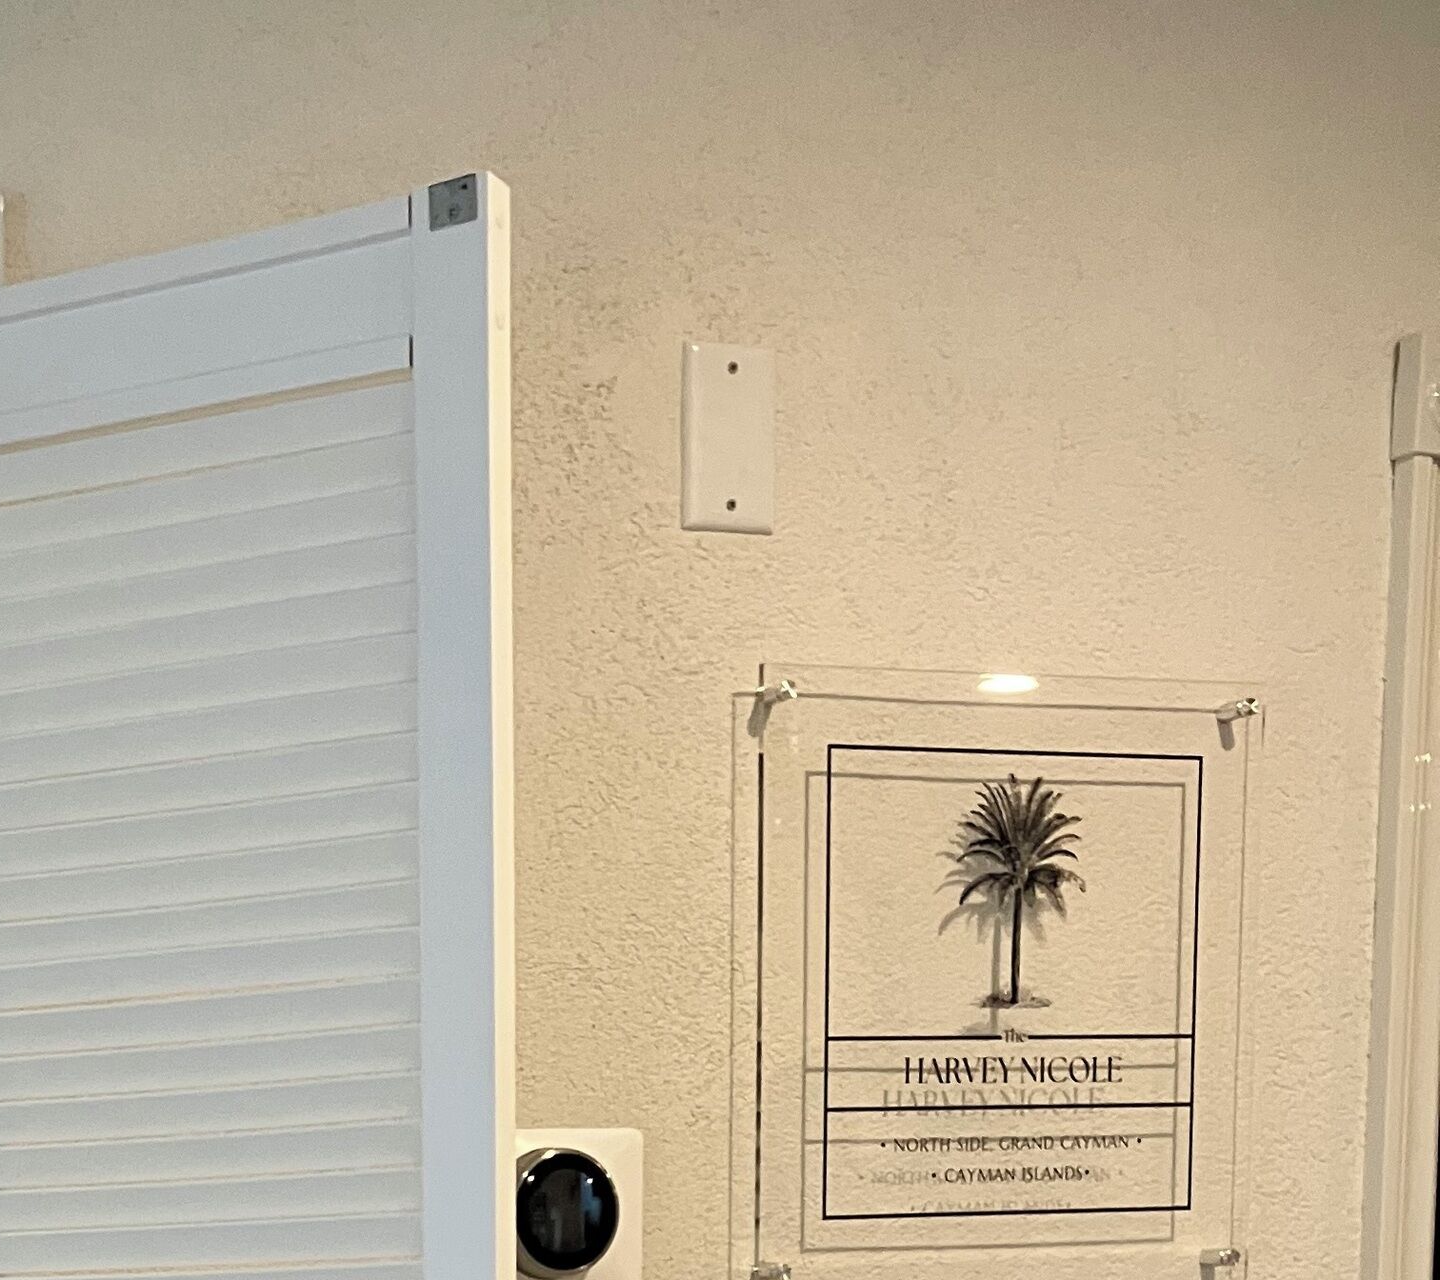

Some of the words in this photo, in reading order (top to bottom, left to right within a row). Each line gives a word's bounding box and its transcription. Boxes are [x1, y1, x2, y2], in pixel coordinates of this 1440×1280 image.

[1002, 1028, 1027, 1044] The
[904, 1056, 1015, 1084] HARVEY
[1020, 1055, 1123, 1084] NICOLE
[893, 1137, 951, 1153] NORTH
[998, 1135, 1054, 1151] GRAND
[1059, 1134, 1129, 1150] CAYMAN
[943, 1167, 1015, 1184] CAYMAN
[1021, 1165, 1084, 1183] ISLANDS
